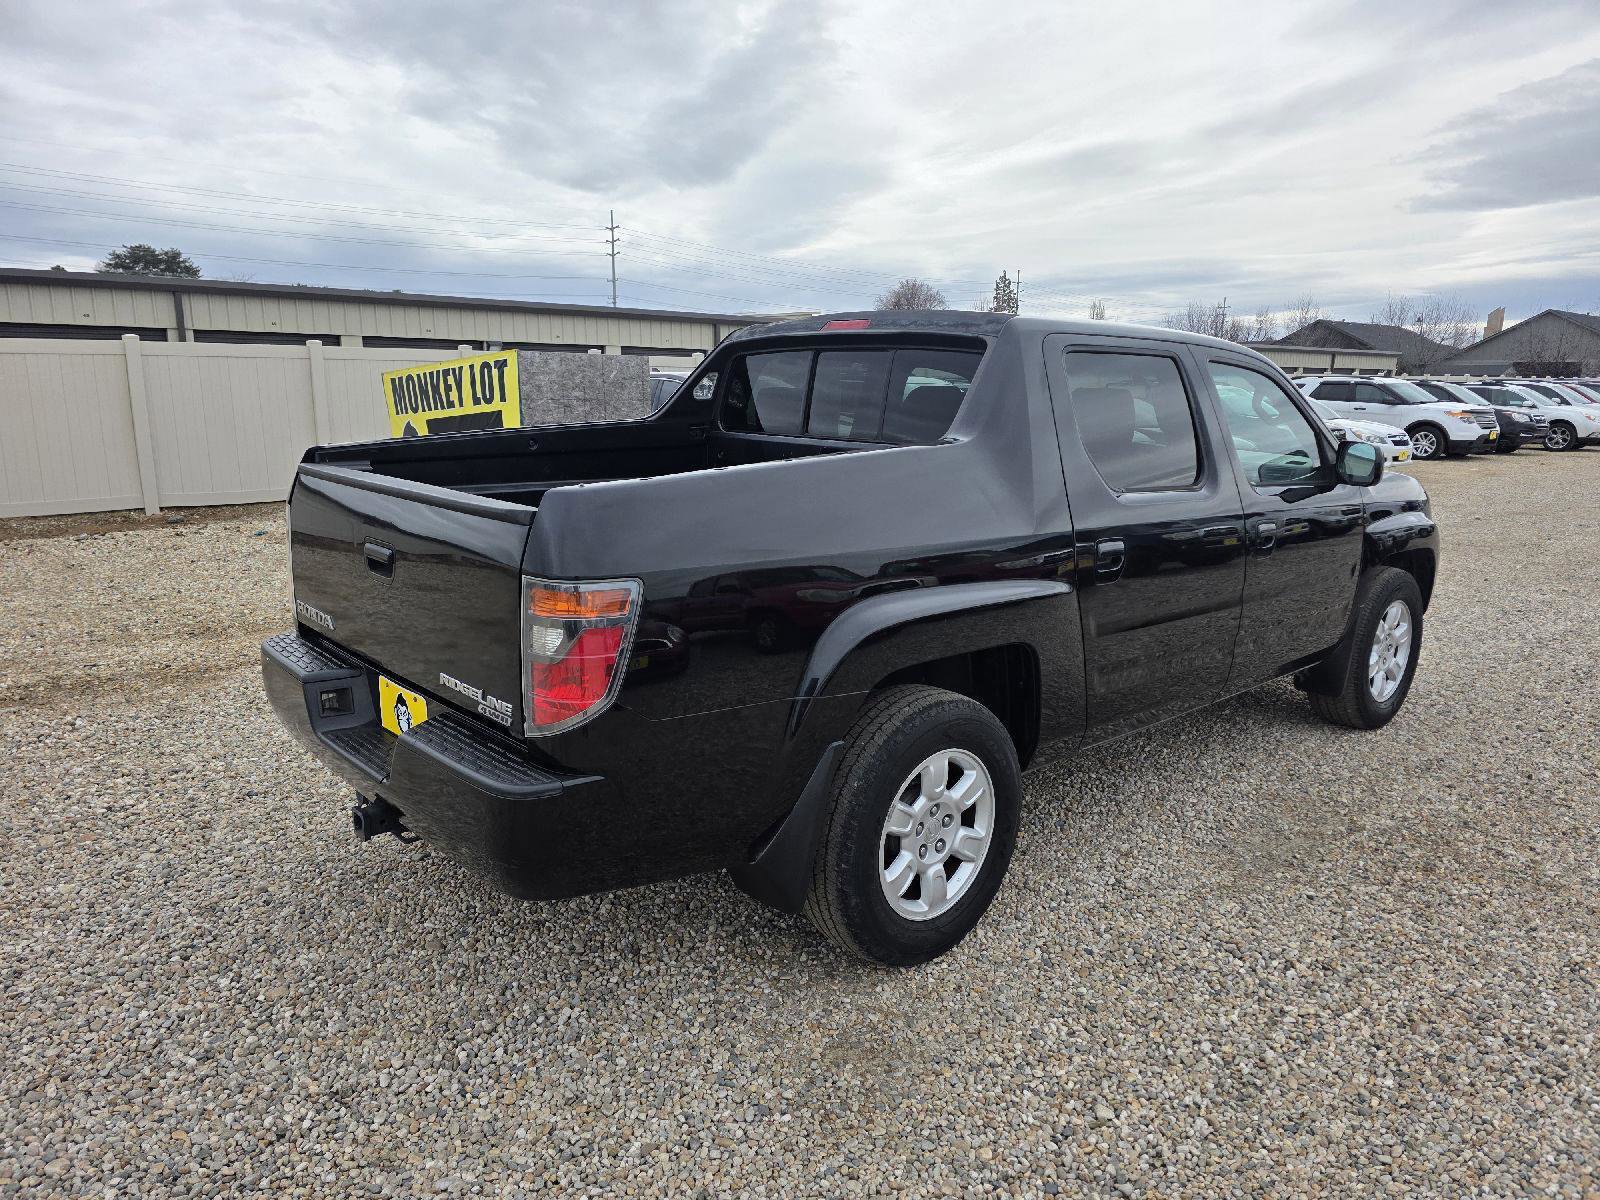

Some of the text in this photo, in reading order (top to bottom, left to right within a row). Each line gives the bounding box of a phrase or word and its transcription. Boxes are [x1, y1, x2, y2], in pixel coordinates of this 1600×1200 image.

[390, 358, 508, 416] MONKEY LOT
[296, 599, 335, 630] HONDA
[439, 672, 513, 717] RIDGELINE
